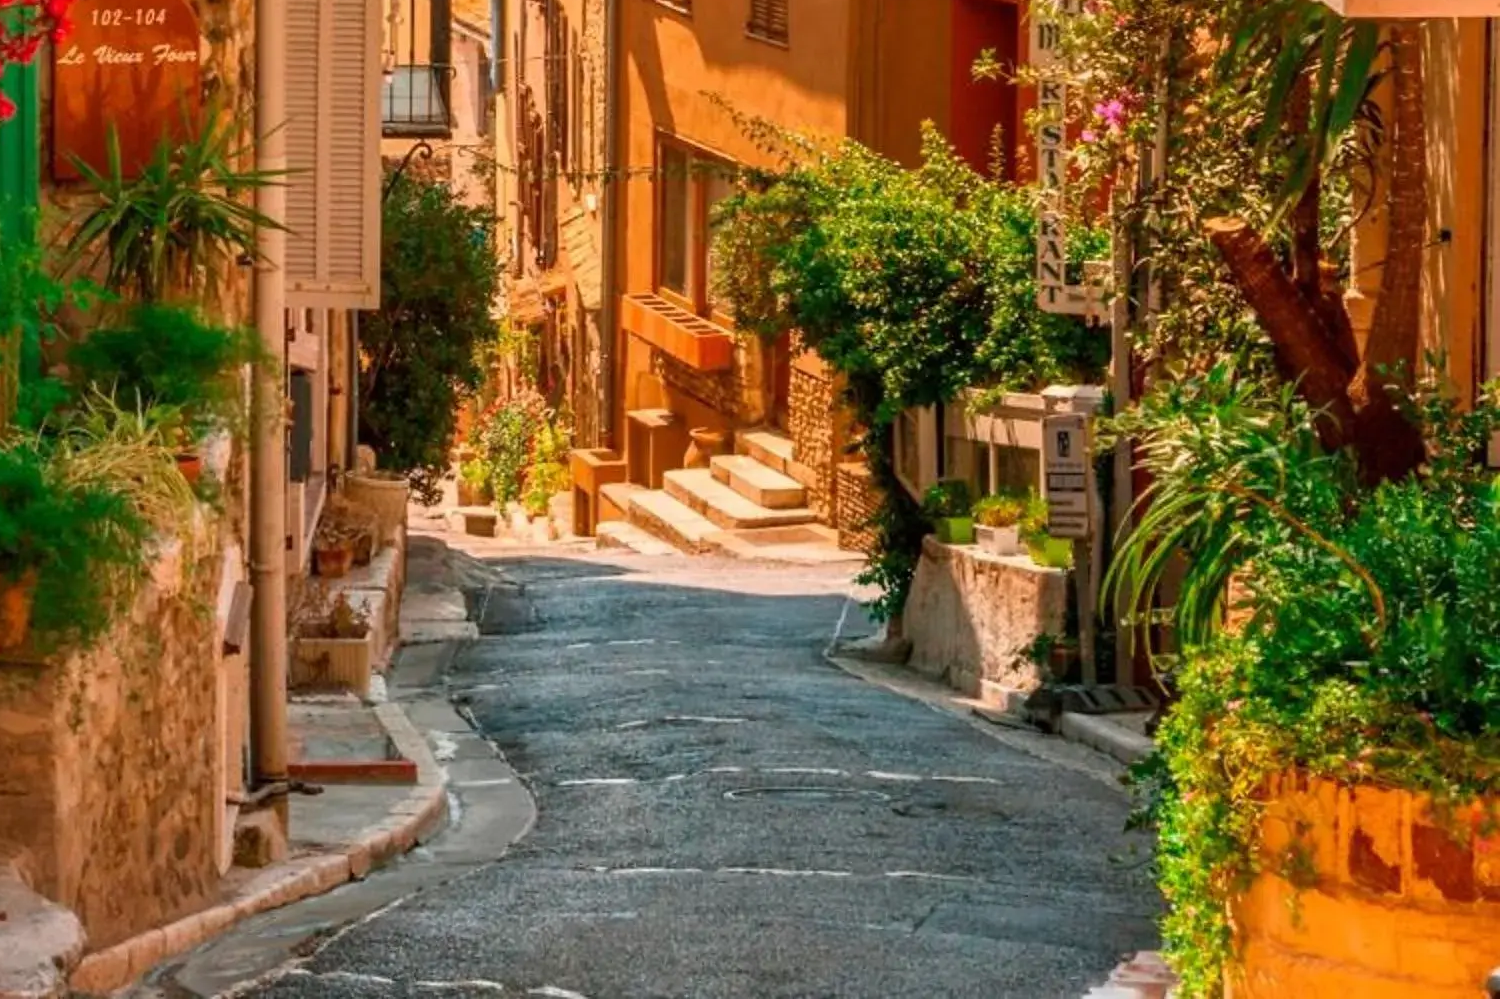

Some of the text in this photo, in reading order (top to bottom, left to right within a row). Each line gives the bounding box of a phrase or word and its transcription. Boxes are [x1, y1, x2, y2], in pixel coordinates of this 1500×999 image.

[91, 8, 167, 26] 102-104
[56, 43, 197, 66] Le Vieux Four
